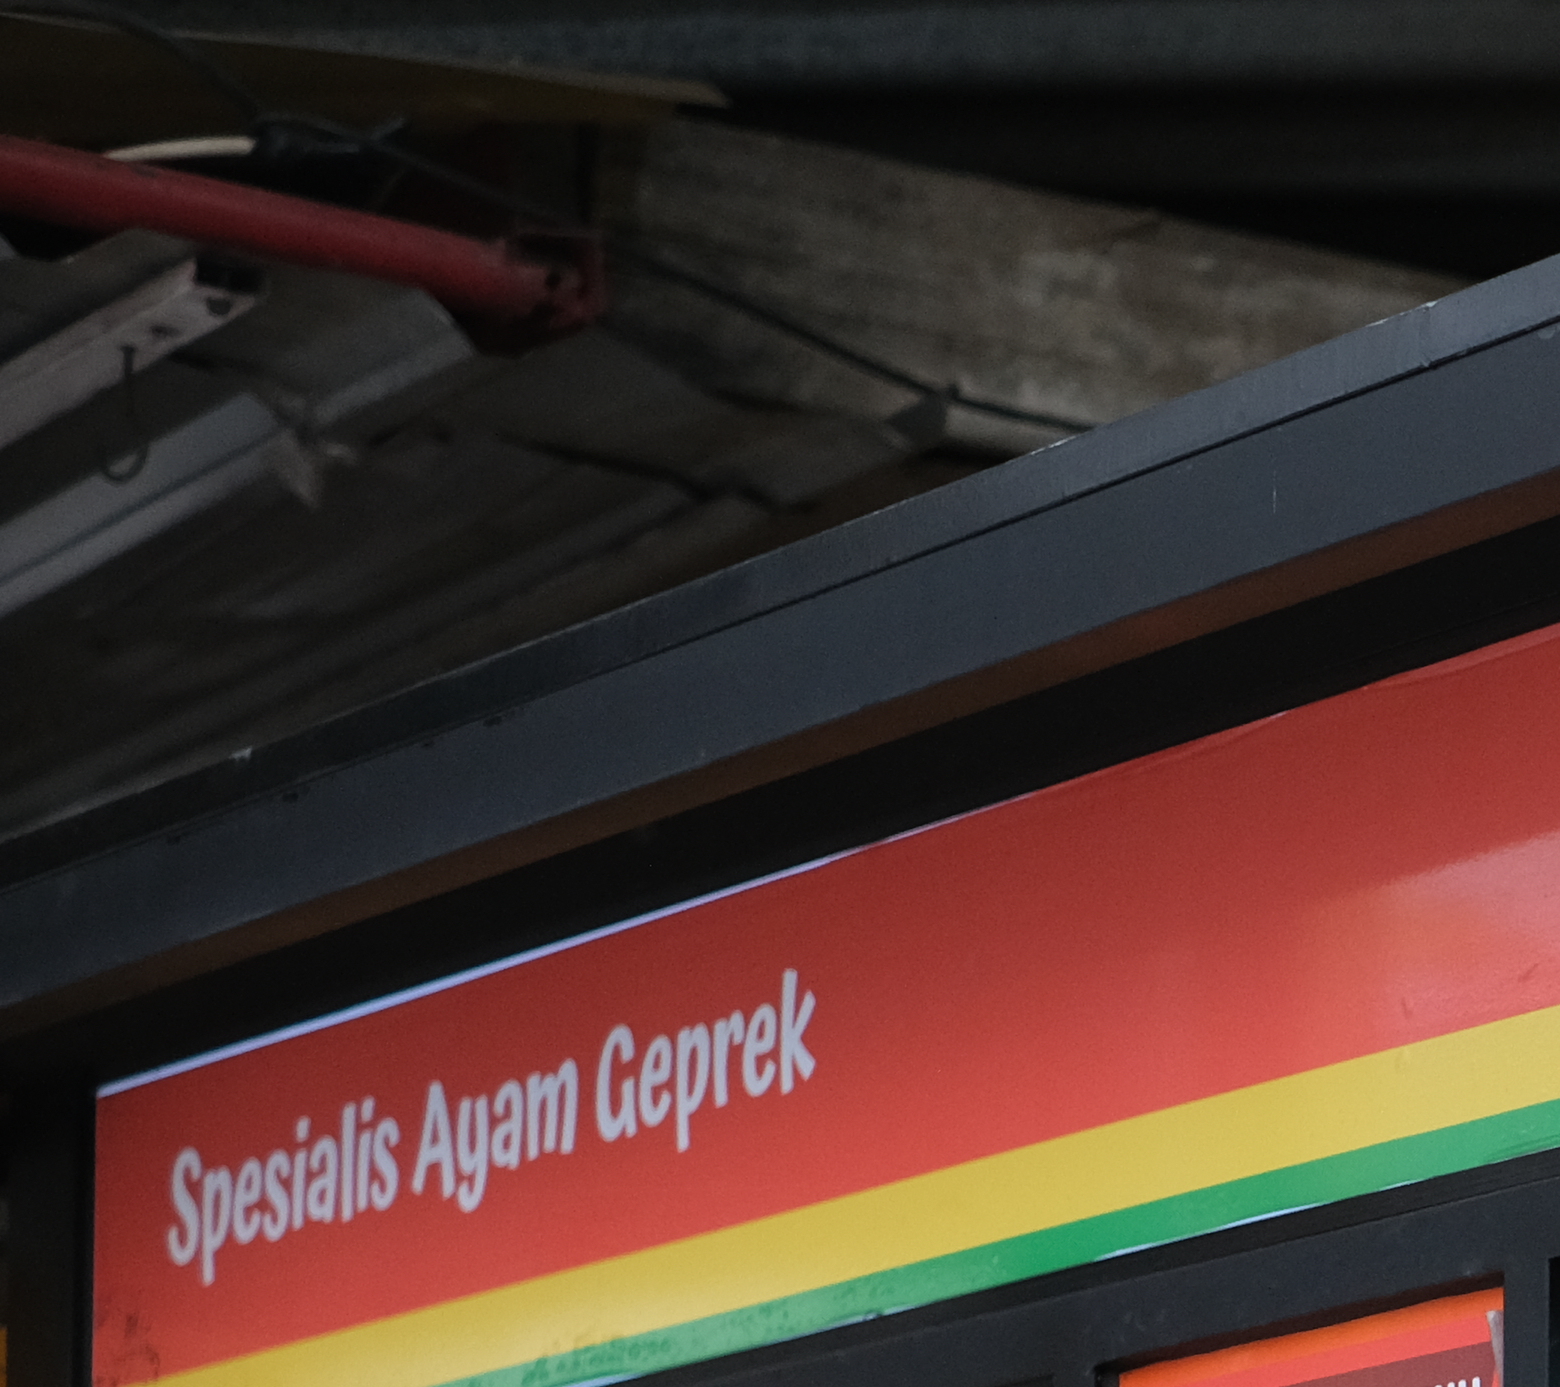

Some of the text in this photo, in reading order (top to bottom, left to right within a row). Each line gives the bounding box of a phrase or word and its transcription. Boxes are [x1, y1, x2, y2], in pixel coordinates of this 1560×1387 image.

[167, 969, 817, 1286] Spesialis Ayam Geprek
